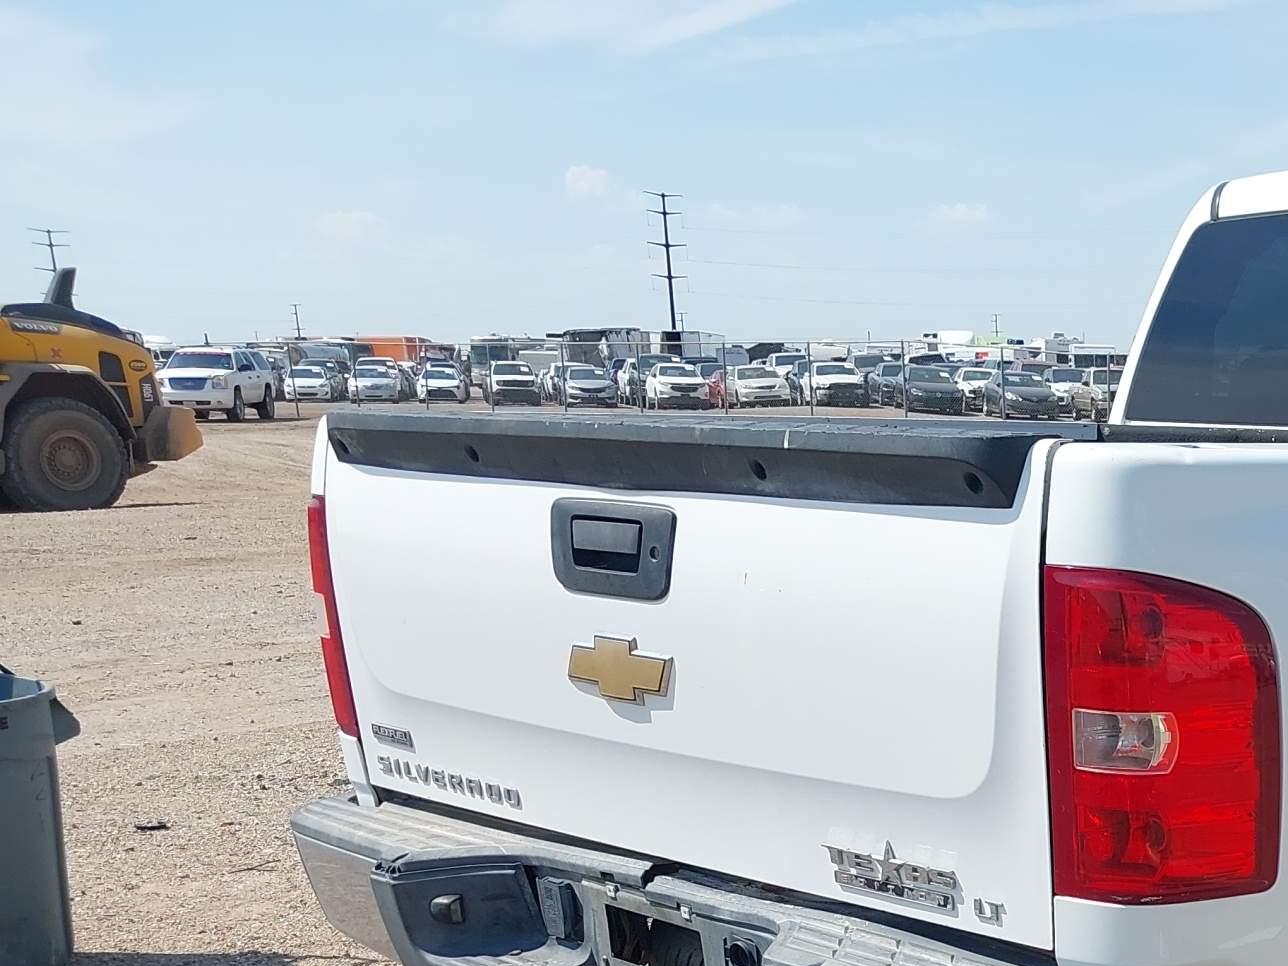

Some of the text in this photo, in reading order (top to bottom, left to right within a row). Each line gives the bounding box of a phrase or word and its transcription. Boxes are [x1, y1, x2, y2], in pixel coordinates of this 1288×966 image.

[12, 321, 58, 332] VOLVO
[377, 754, 523, 811] SILVERADO
[820, 840, 962, 892] TEXAS
[973, 898, 1008, 927] LT
